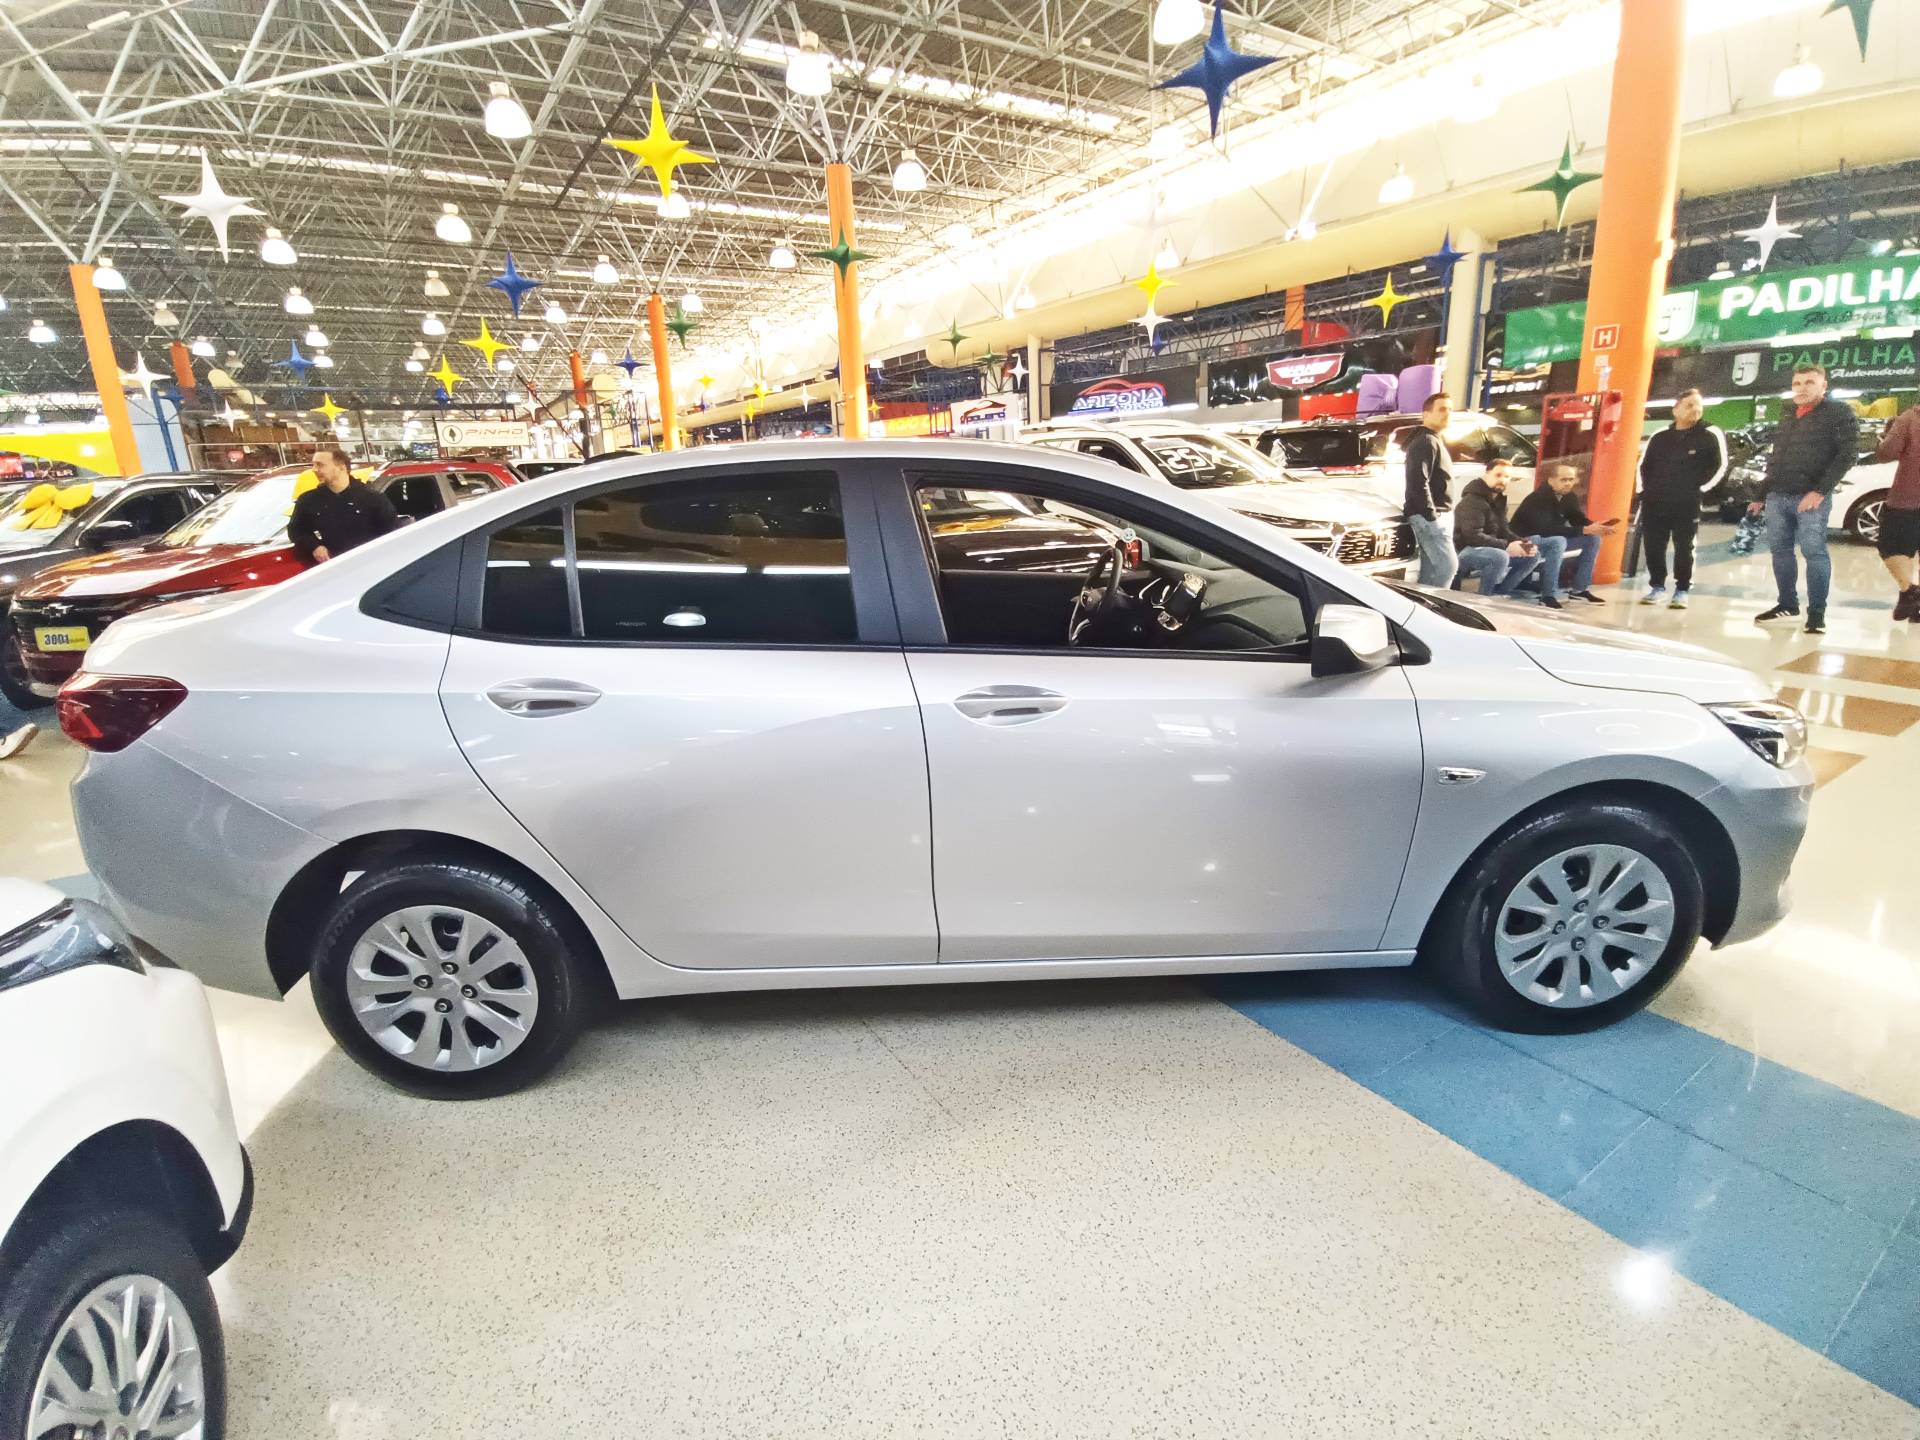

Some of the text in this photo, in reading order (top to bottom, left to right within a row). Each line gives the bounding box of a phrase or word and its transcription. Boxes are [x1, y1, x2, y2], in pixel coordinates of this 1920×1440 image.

[1599, 330, 1612, 346] H
[1773, 343, 1916, 371] PADILHA
[1071, 387, 1163, 411] ARIZONA
[1159, 448, 1207, 470] 25
